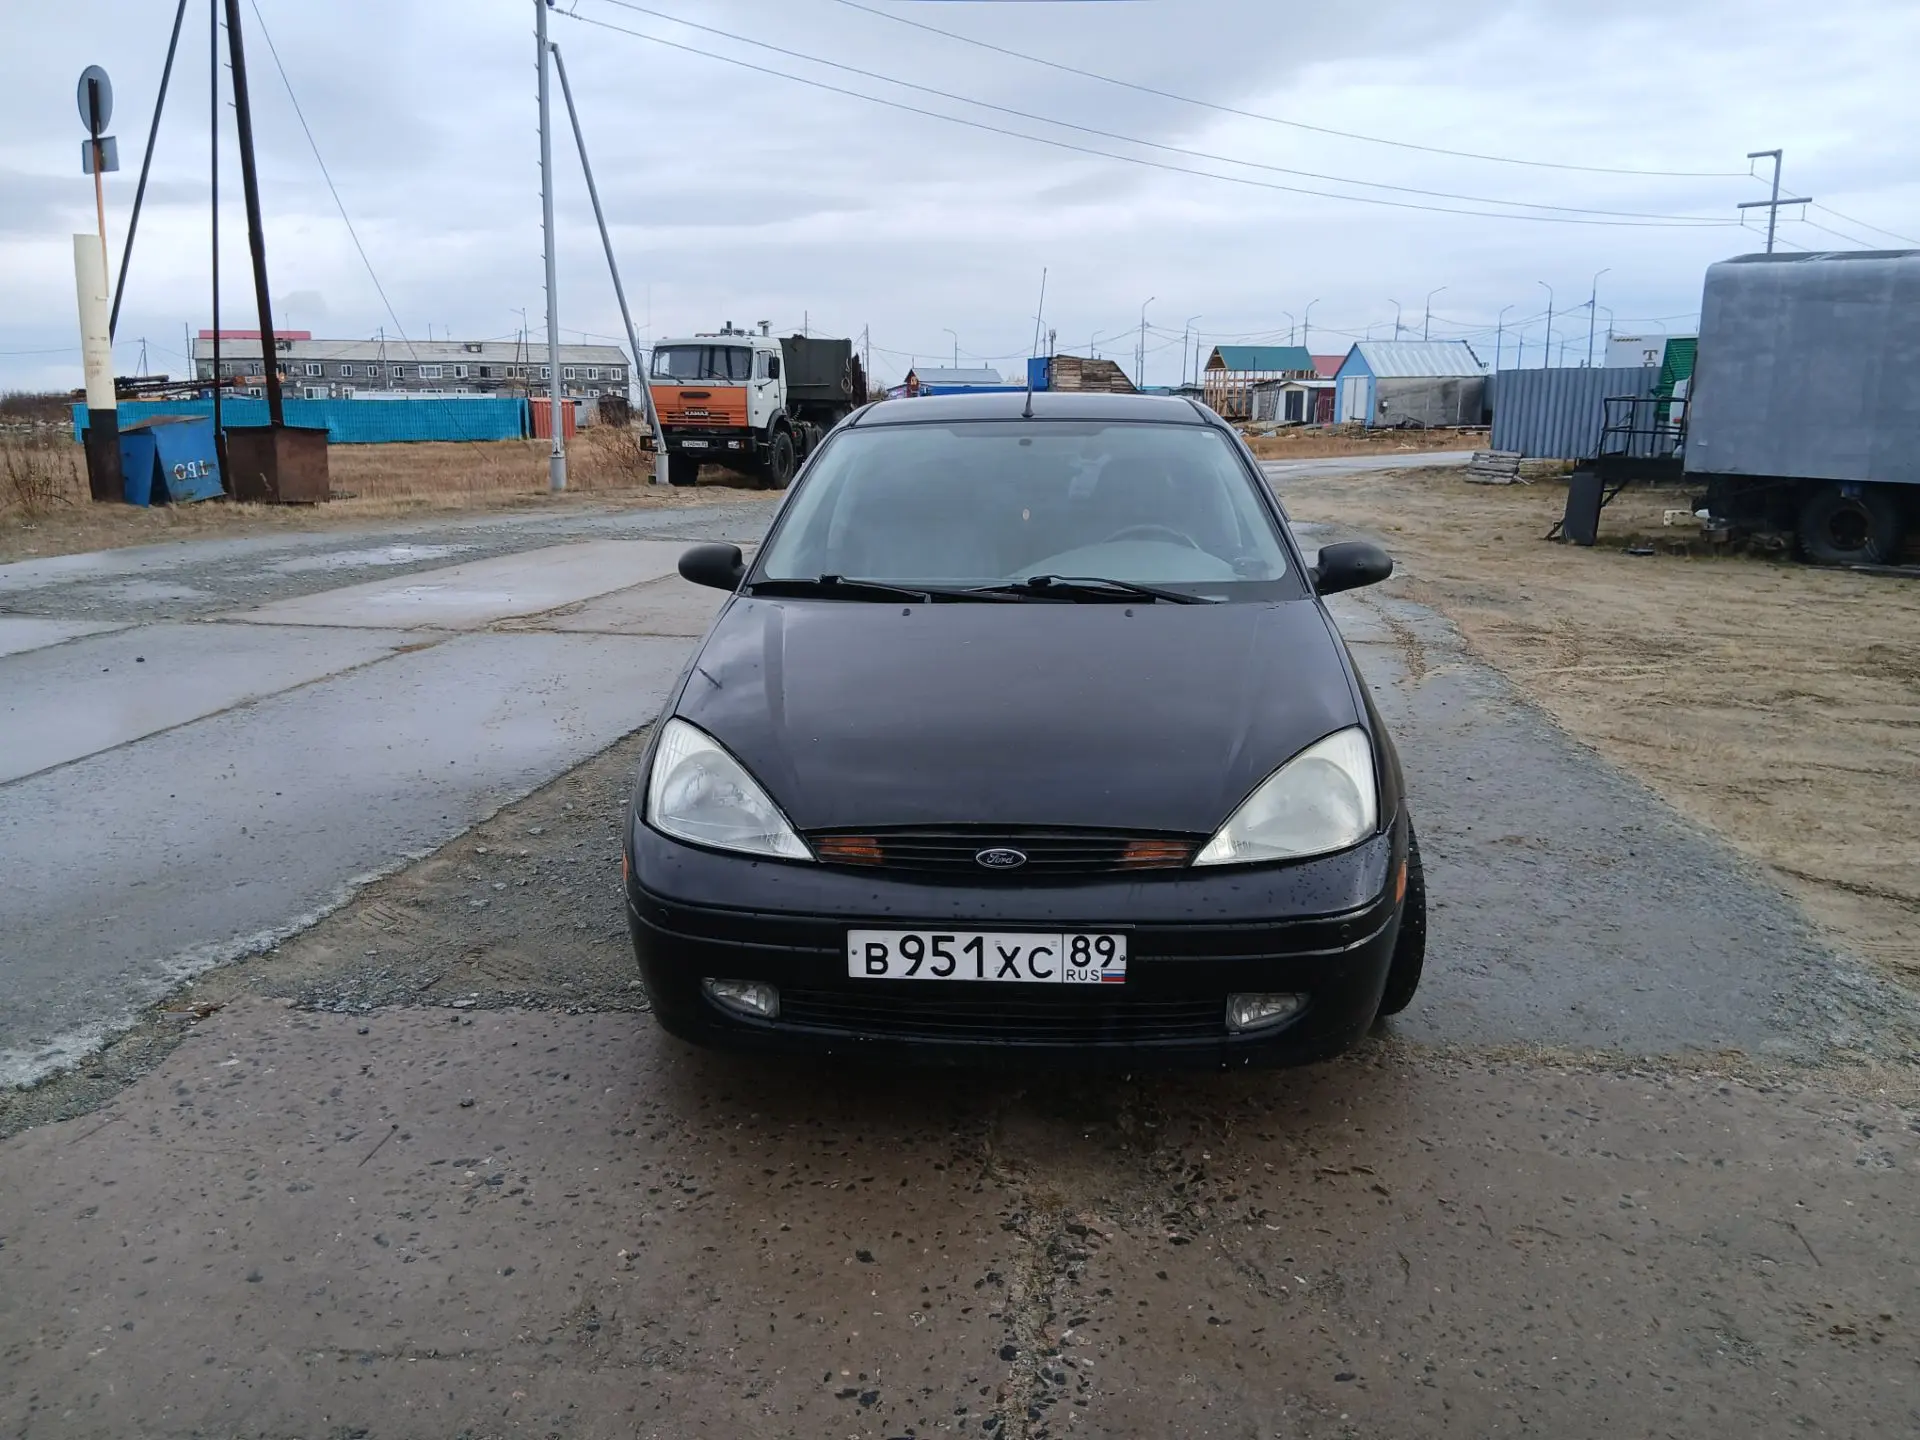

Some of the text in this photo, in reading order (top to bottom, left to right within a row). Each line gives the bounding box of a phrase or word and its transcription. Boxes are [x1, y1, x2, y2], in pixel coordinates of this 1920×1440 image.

[986, 852, 1015, 864] Ford
[1070, 935, 1115, 967] 89
[1066, 969, 1100, 981] RUS
